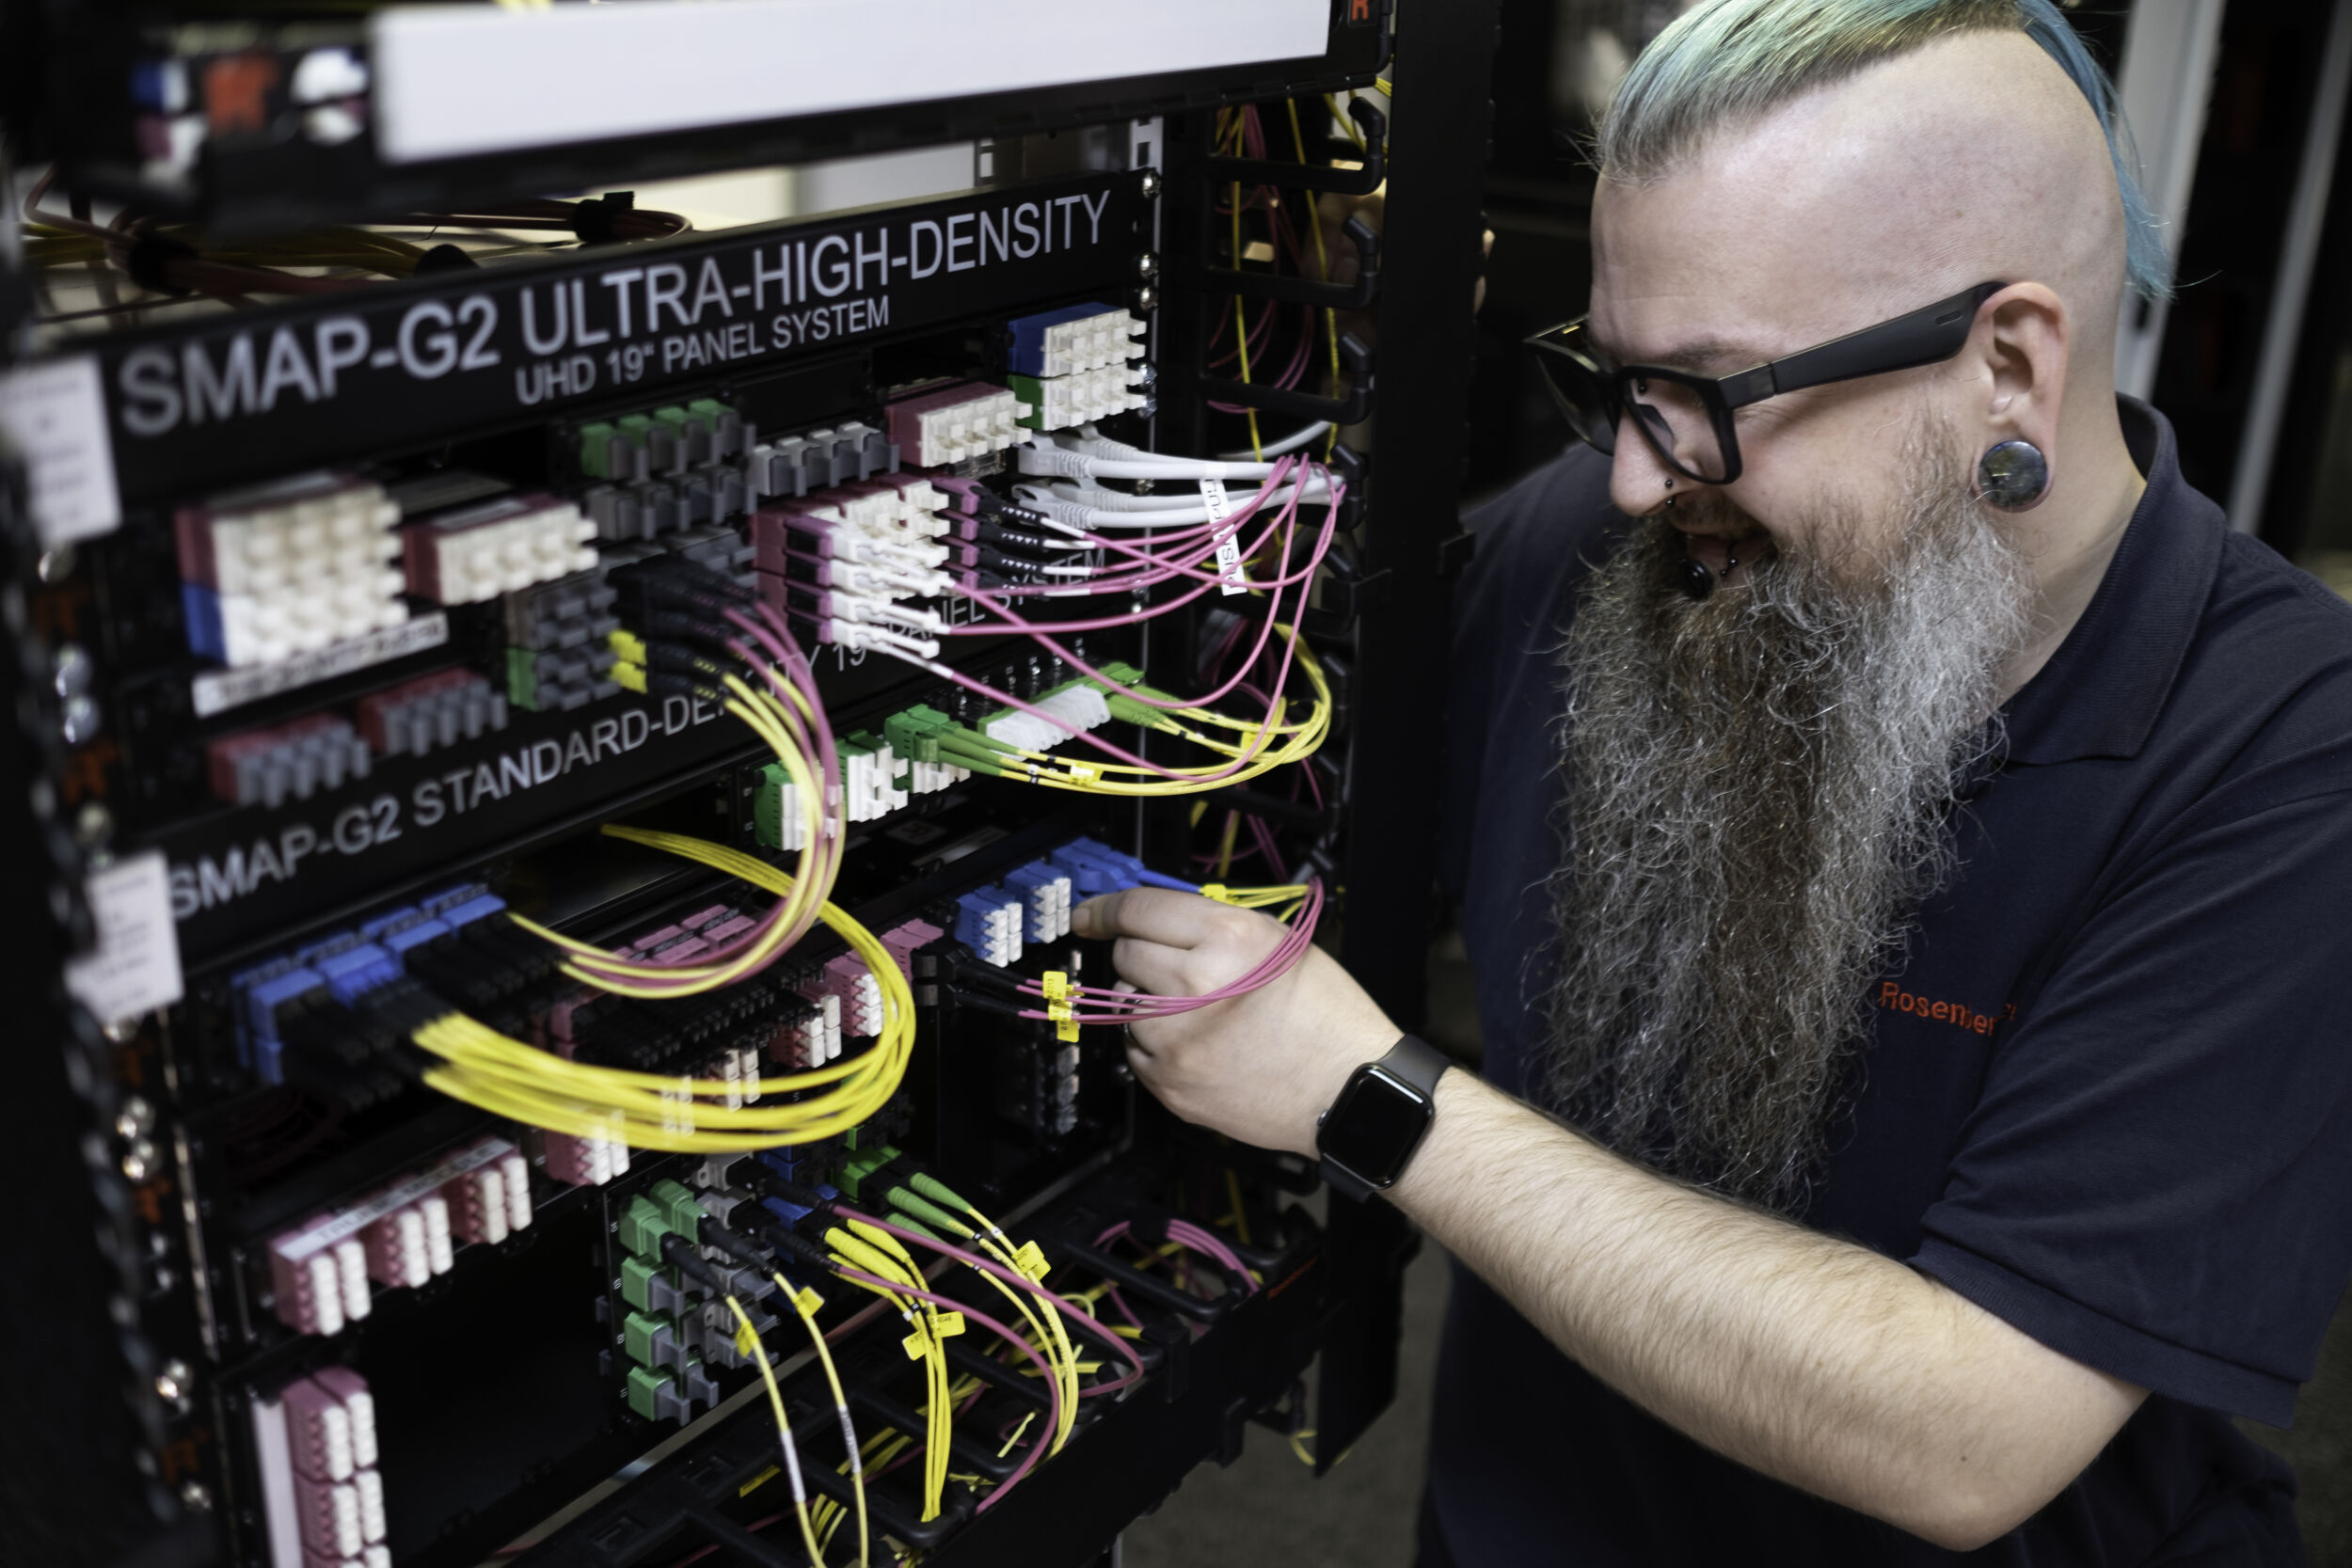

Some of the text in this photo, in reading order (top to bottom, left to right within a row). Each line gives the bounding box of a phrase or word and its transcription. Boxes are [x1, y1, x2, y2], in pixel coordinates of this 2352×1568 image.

[118, 190, 1111, 437] SMAP-G2 ULTRA-HIGH-DENSITY
[516, 356, 596, 406] UHD
[663, 321, 766, 373] PANEL
[772, 295, 890, 350] SYSTEM
[167, 795, 402, 920] SMAP-G2
[412, 645, 821, 828] STANDARD-DEITY
[1881, 981, 2018, 1037] Rosenber
